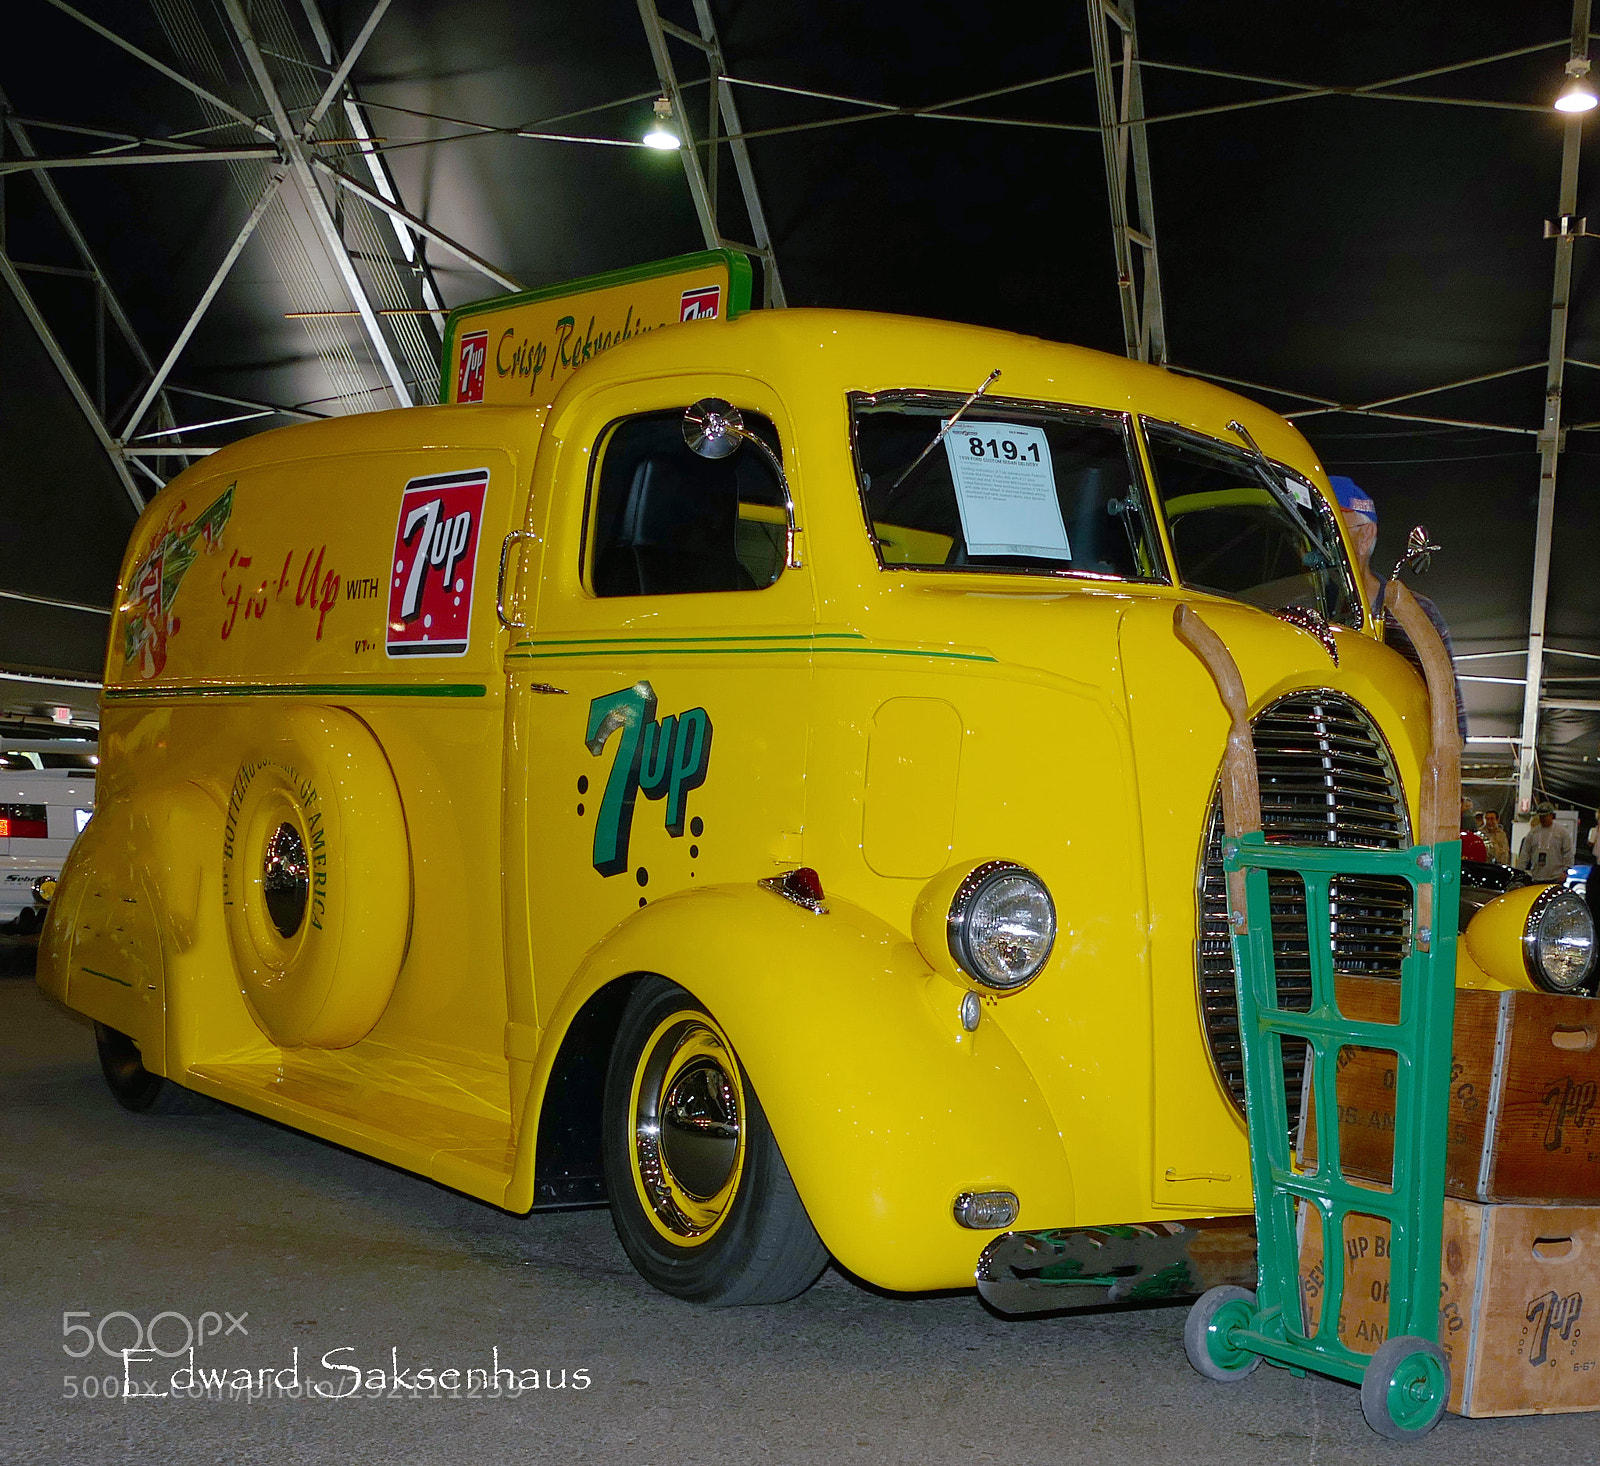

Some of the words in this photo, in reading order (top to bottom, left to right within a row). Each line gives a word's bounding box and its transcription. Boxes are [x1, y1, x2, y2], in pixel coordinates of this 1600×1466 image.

[496, 328, 547, 397] Crisp
[968, 437, 1041, 463] 819.1
[295, 544, 342, 643] Up
[345, 577, 380, 601] WITH
[307, 811, 329, 932] AMERICA
[1346, 1236, 1369, 1260] UP
[1572, 1361, 1597, 1373] 6-67
